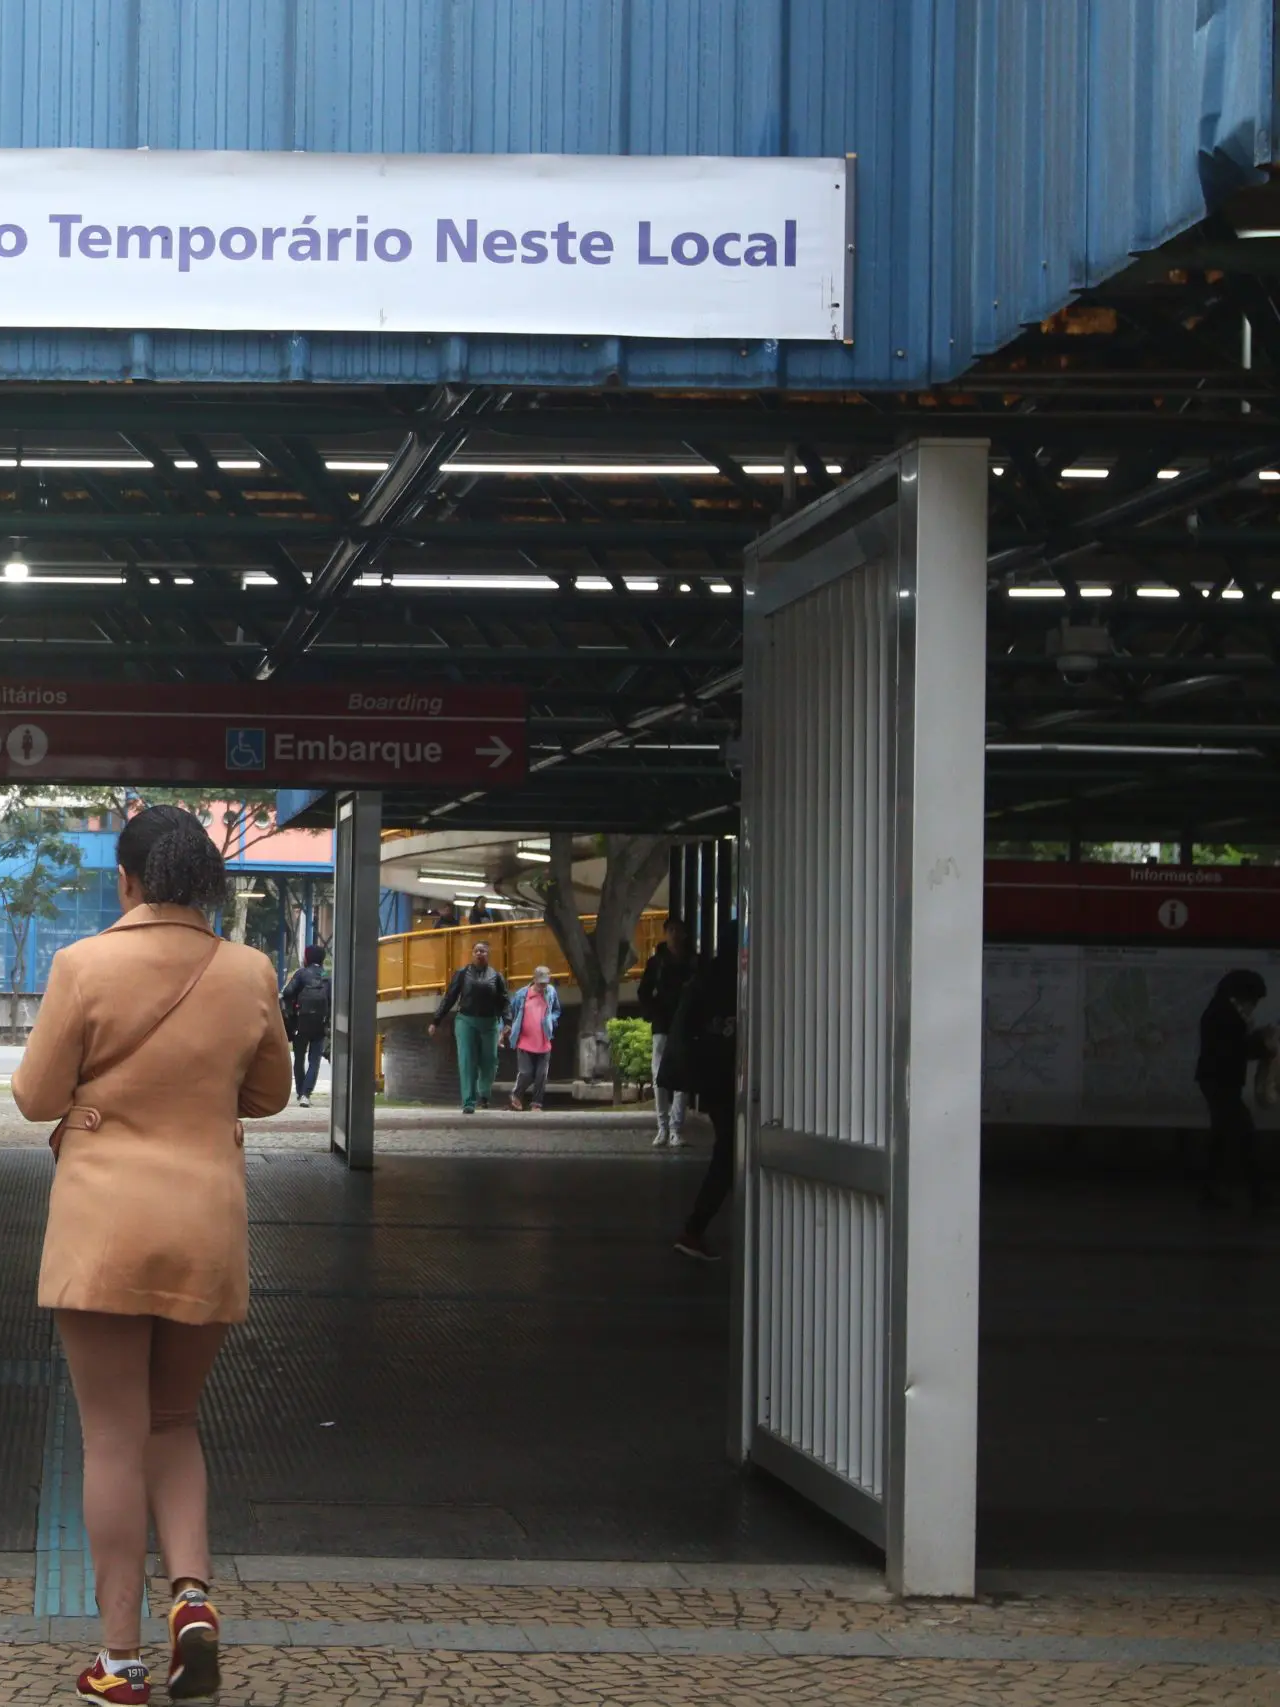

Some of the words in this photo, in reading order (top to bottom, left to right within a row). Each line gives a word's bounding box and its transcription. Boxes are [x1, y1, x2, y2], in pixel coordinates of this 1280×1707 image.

[49, 214, 412, 273] Temporário
[436, 218, 614, 265] Neste
[638, 219, 797, 267] Local
[347, 693, 443, 716] Boarding
[274, 733, 443, 769] Embarque
[1130, 868, 1223, 885] Informações
[127, 1668, 144, 1678] 1911
